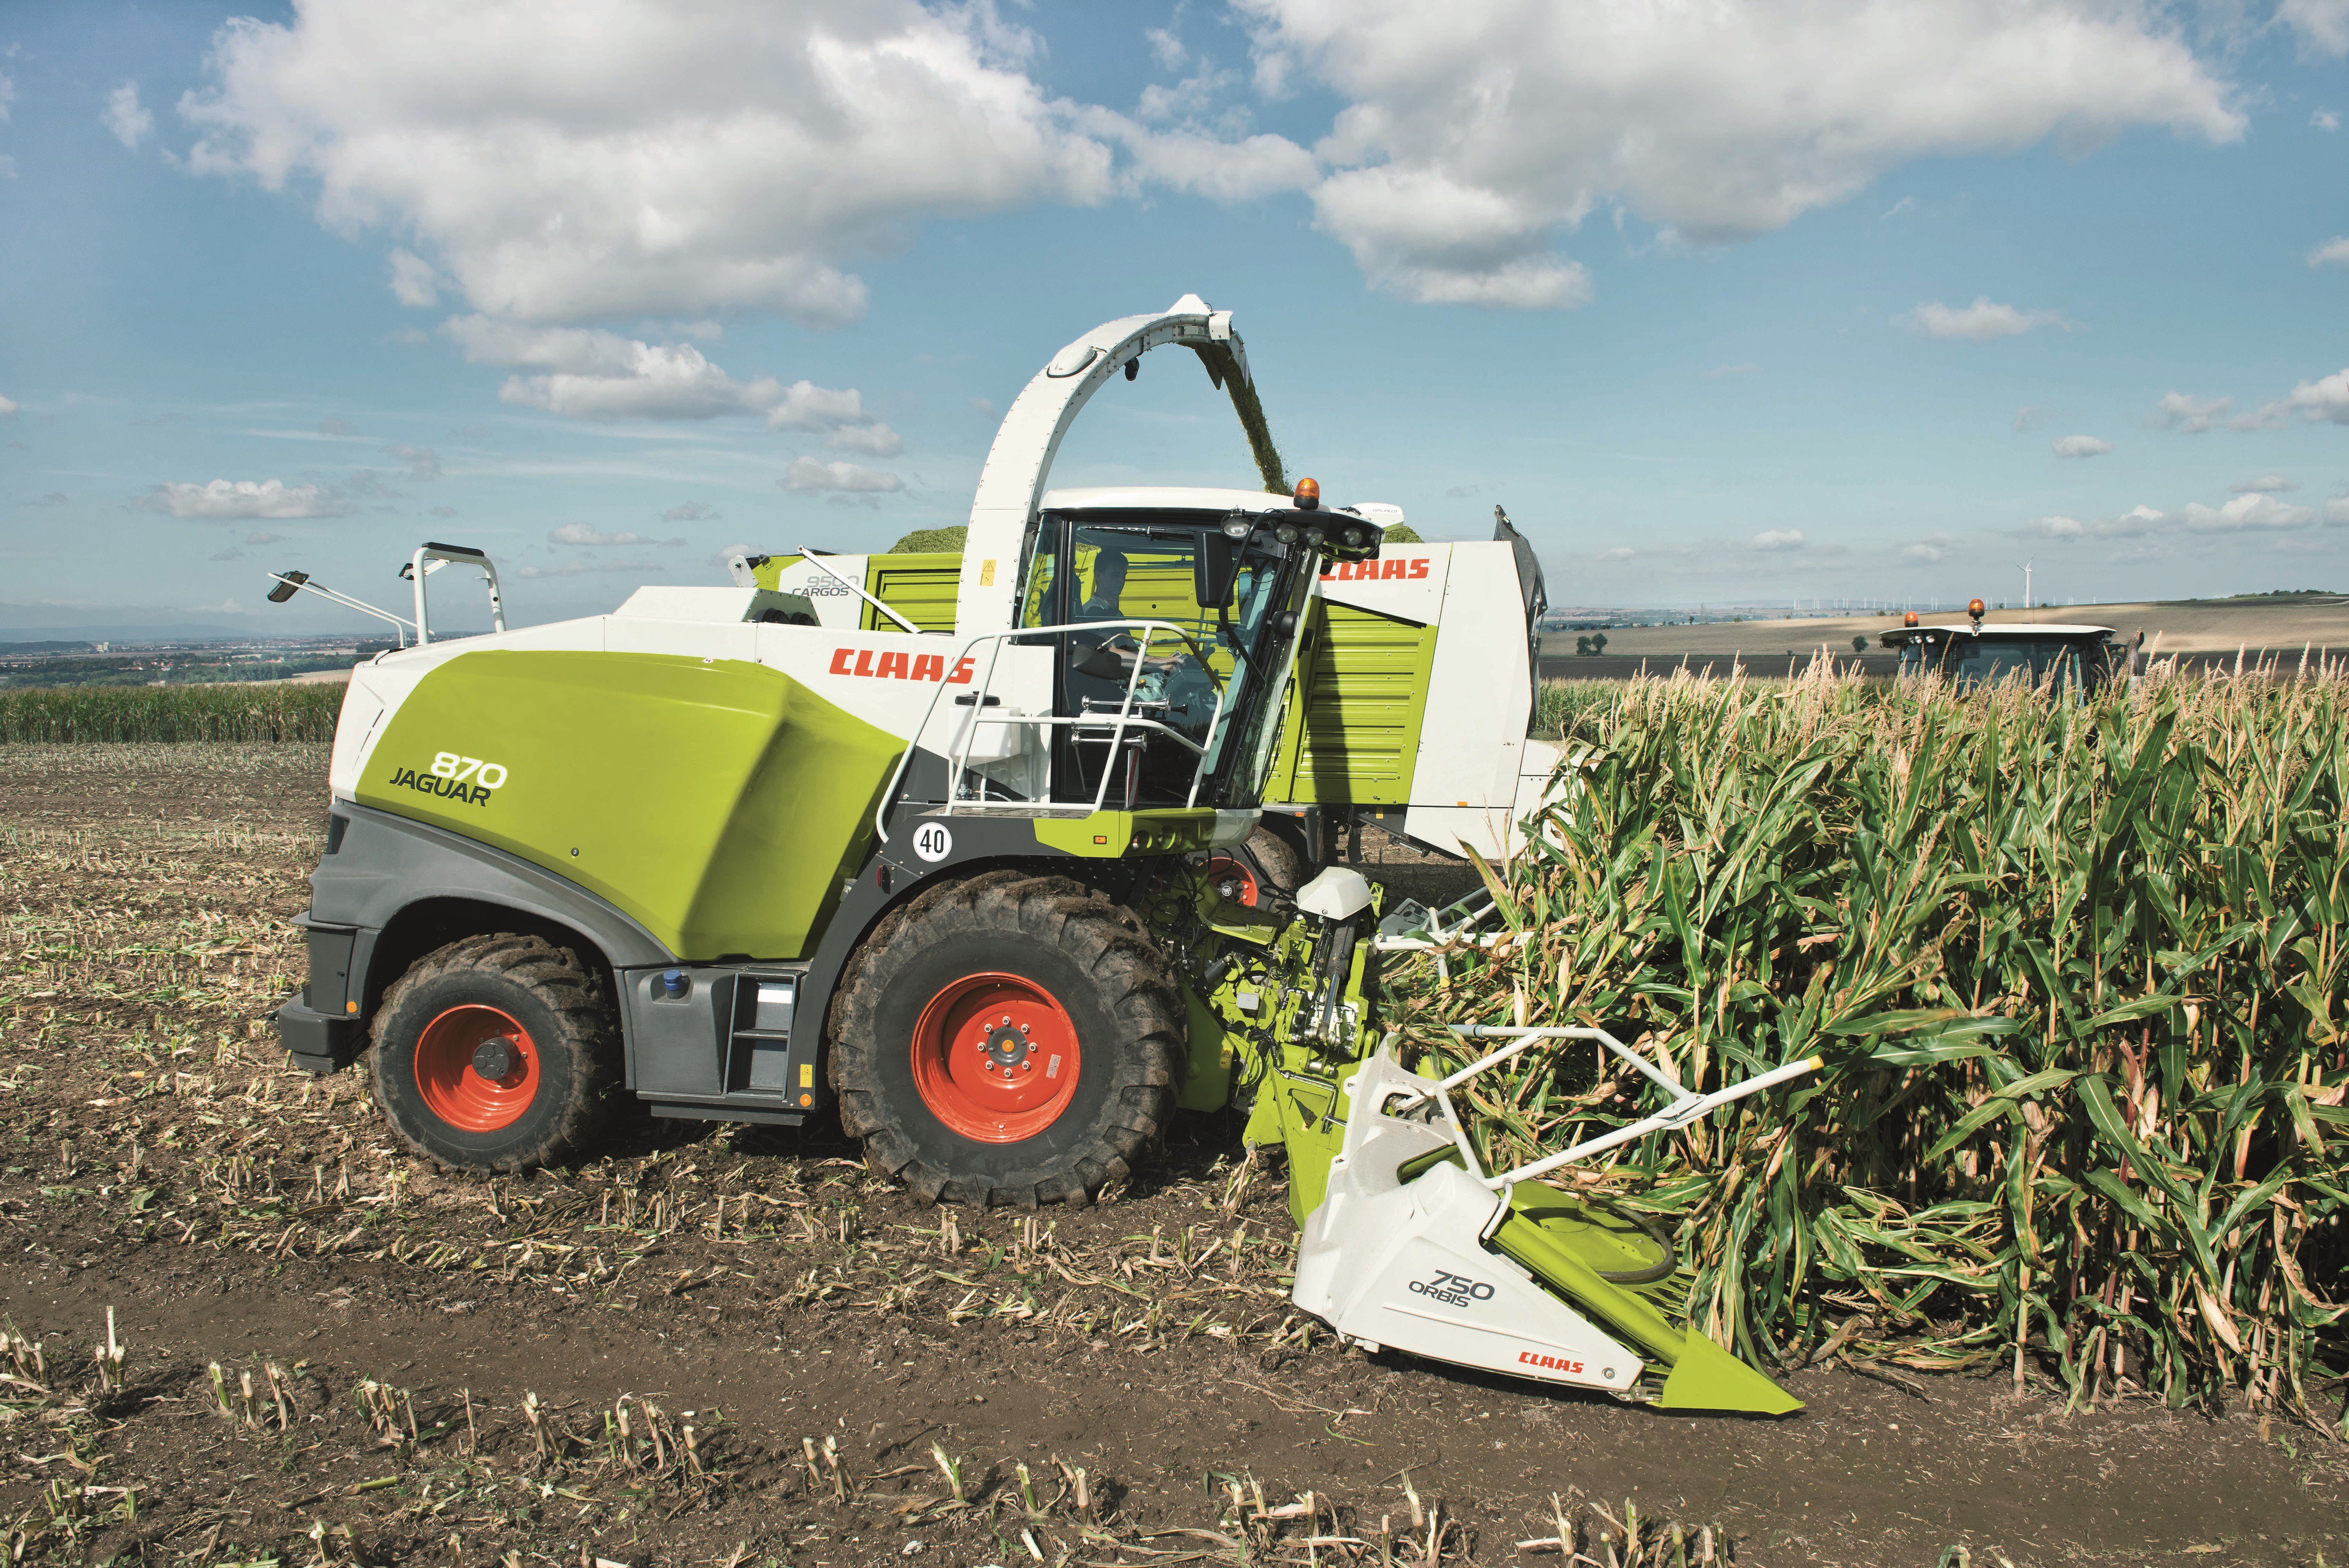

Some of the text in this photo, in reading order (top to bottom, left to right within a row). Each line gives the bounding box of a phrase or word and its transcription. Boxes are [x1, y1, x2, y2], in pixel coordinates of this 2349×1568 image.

[792, 587, 850, 596] CARGOS
[829, 648, 976, 684] CLAAS
[430, 751, 508, 789] 870
[389, 767, 491, 807] JAGUAR
[919, 829, 945, 854] 40
[1408, 1280, 1472, 1308] ORBIS
[1430, 1269, 1495, 1301] 750
[1519, 1351, 1585, 1374] CLAAS
